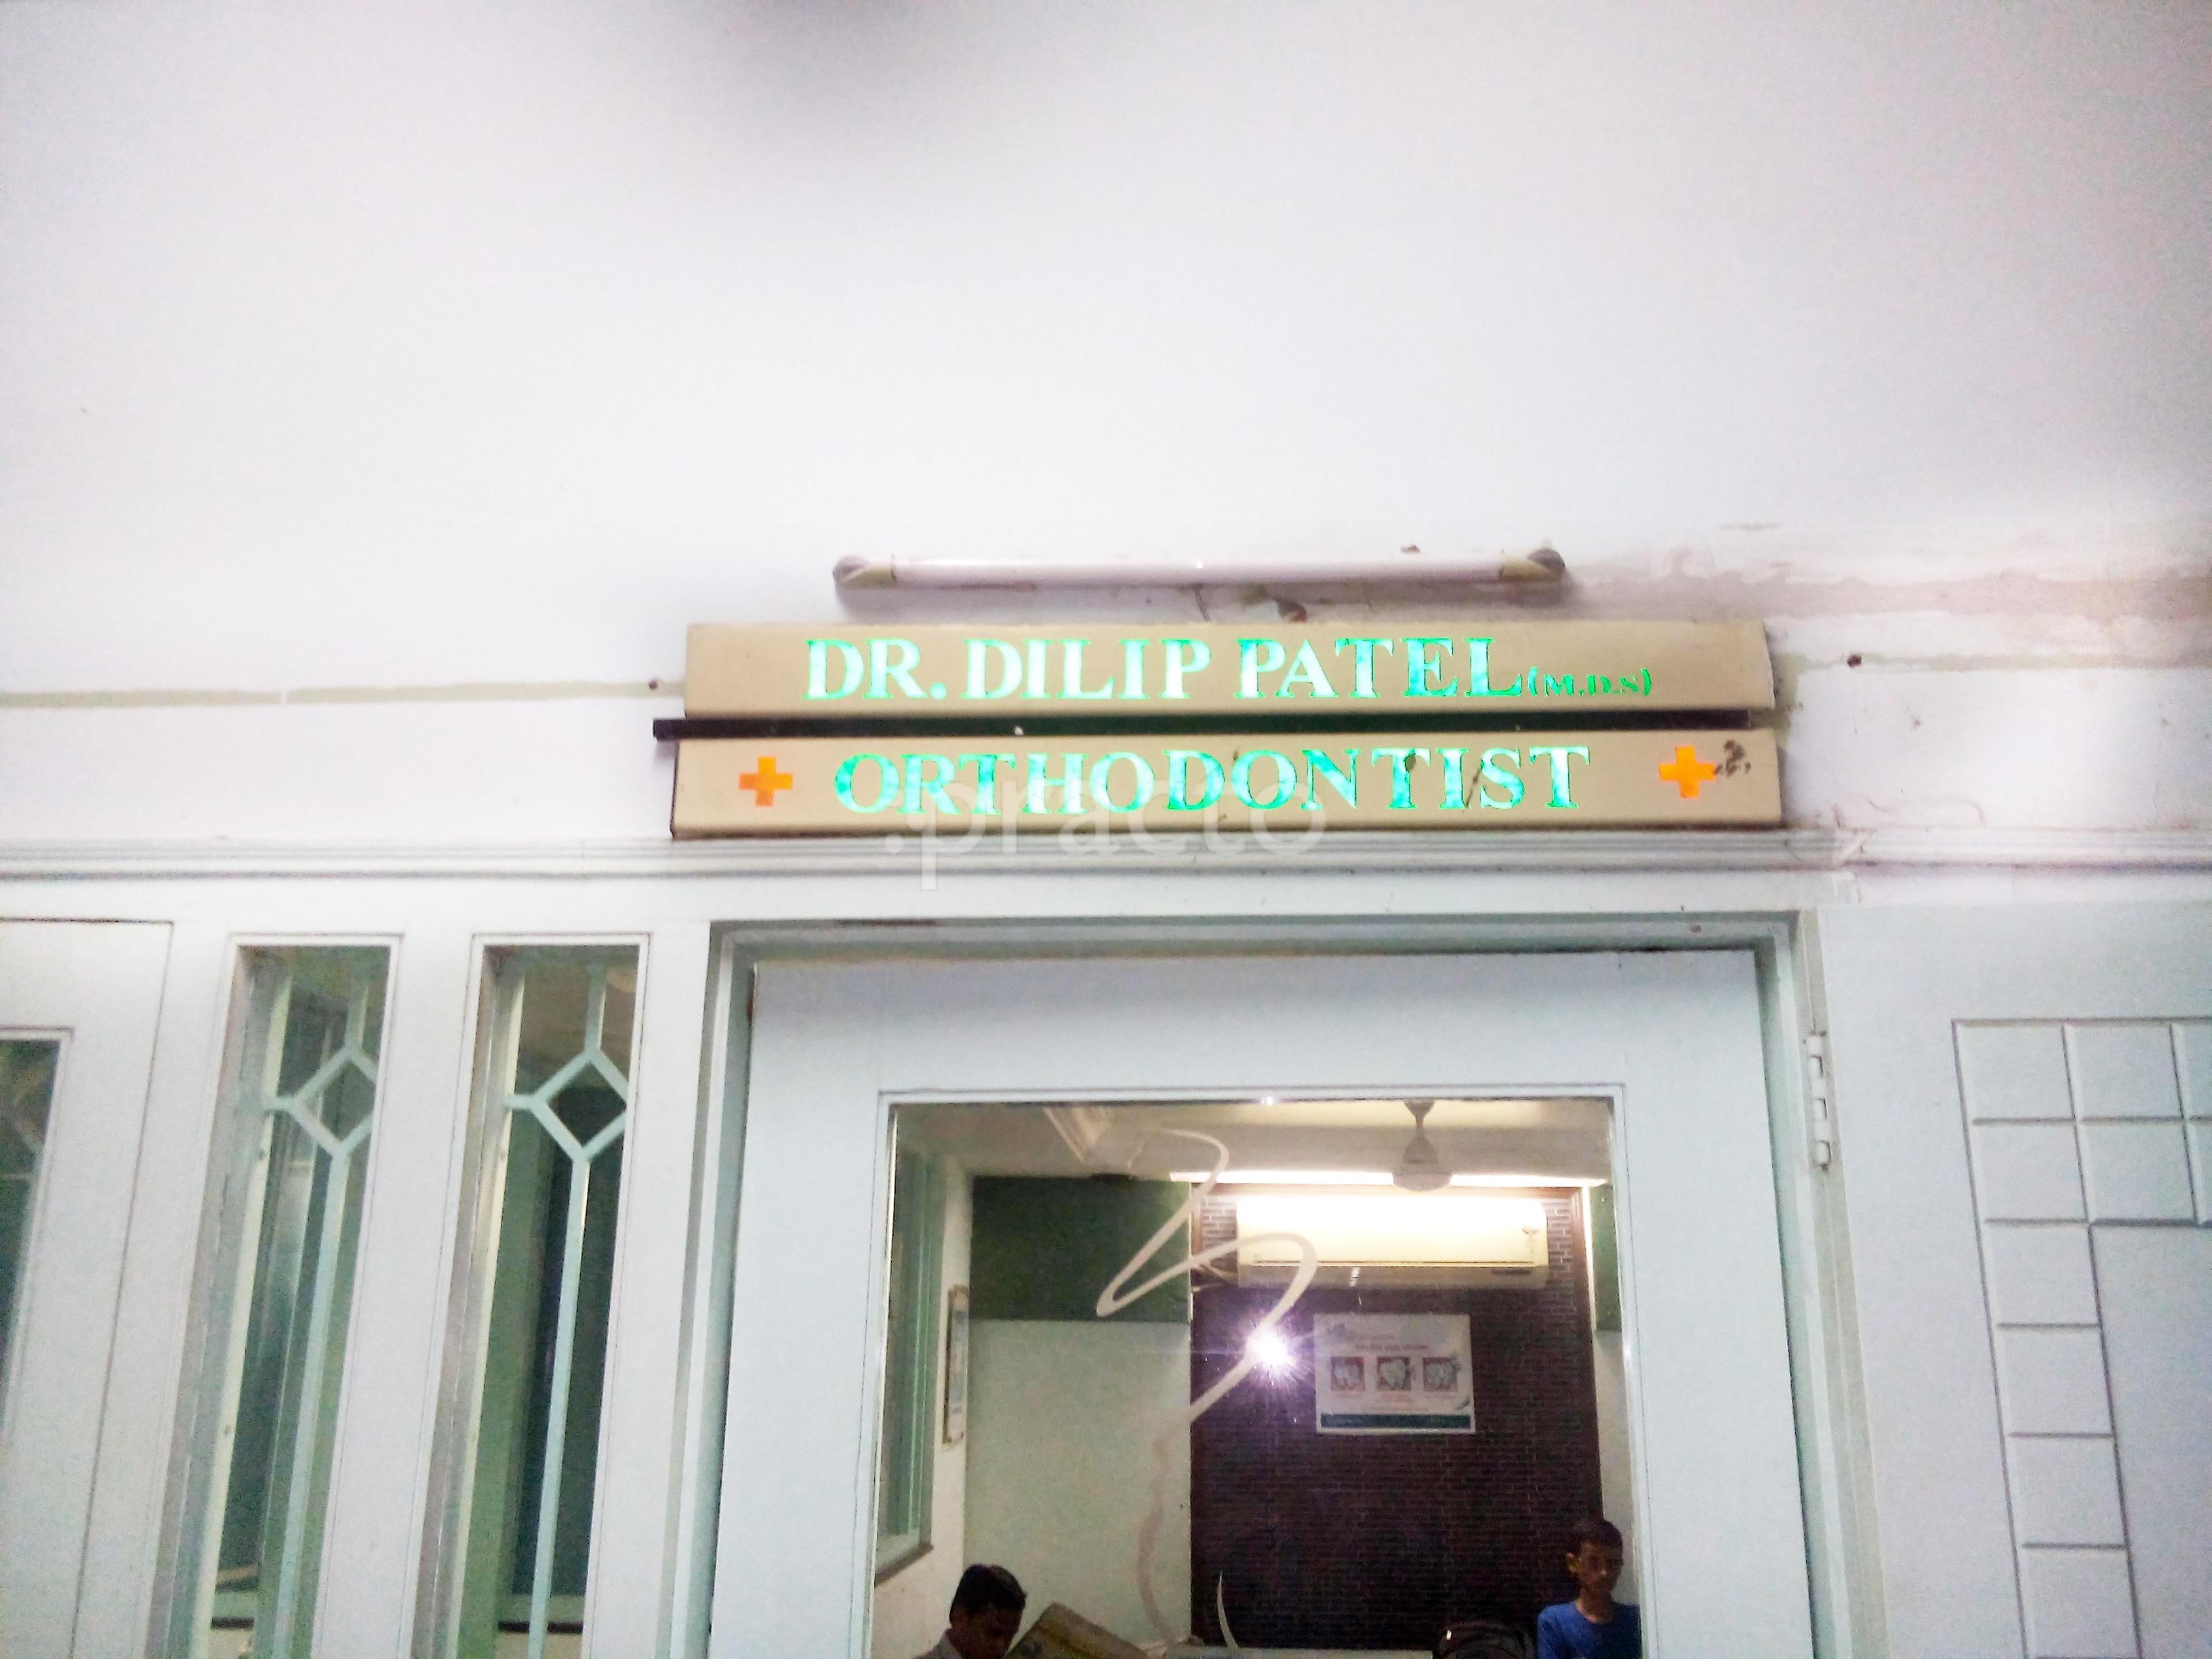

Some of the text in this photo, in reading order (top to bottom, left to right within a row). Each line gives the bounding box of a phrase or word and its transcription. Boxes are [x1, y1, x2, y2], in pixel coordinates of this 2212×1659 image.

[802, 637, 948, 701] DR.
[960, 637, 1213, 701] DILIP
[833, 744, 1590, 815] ORTHODONTIST
